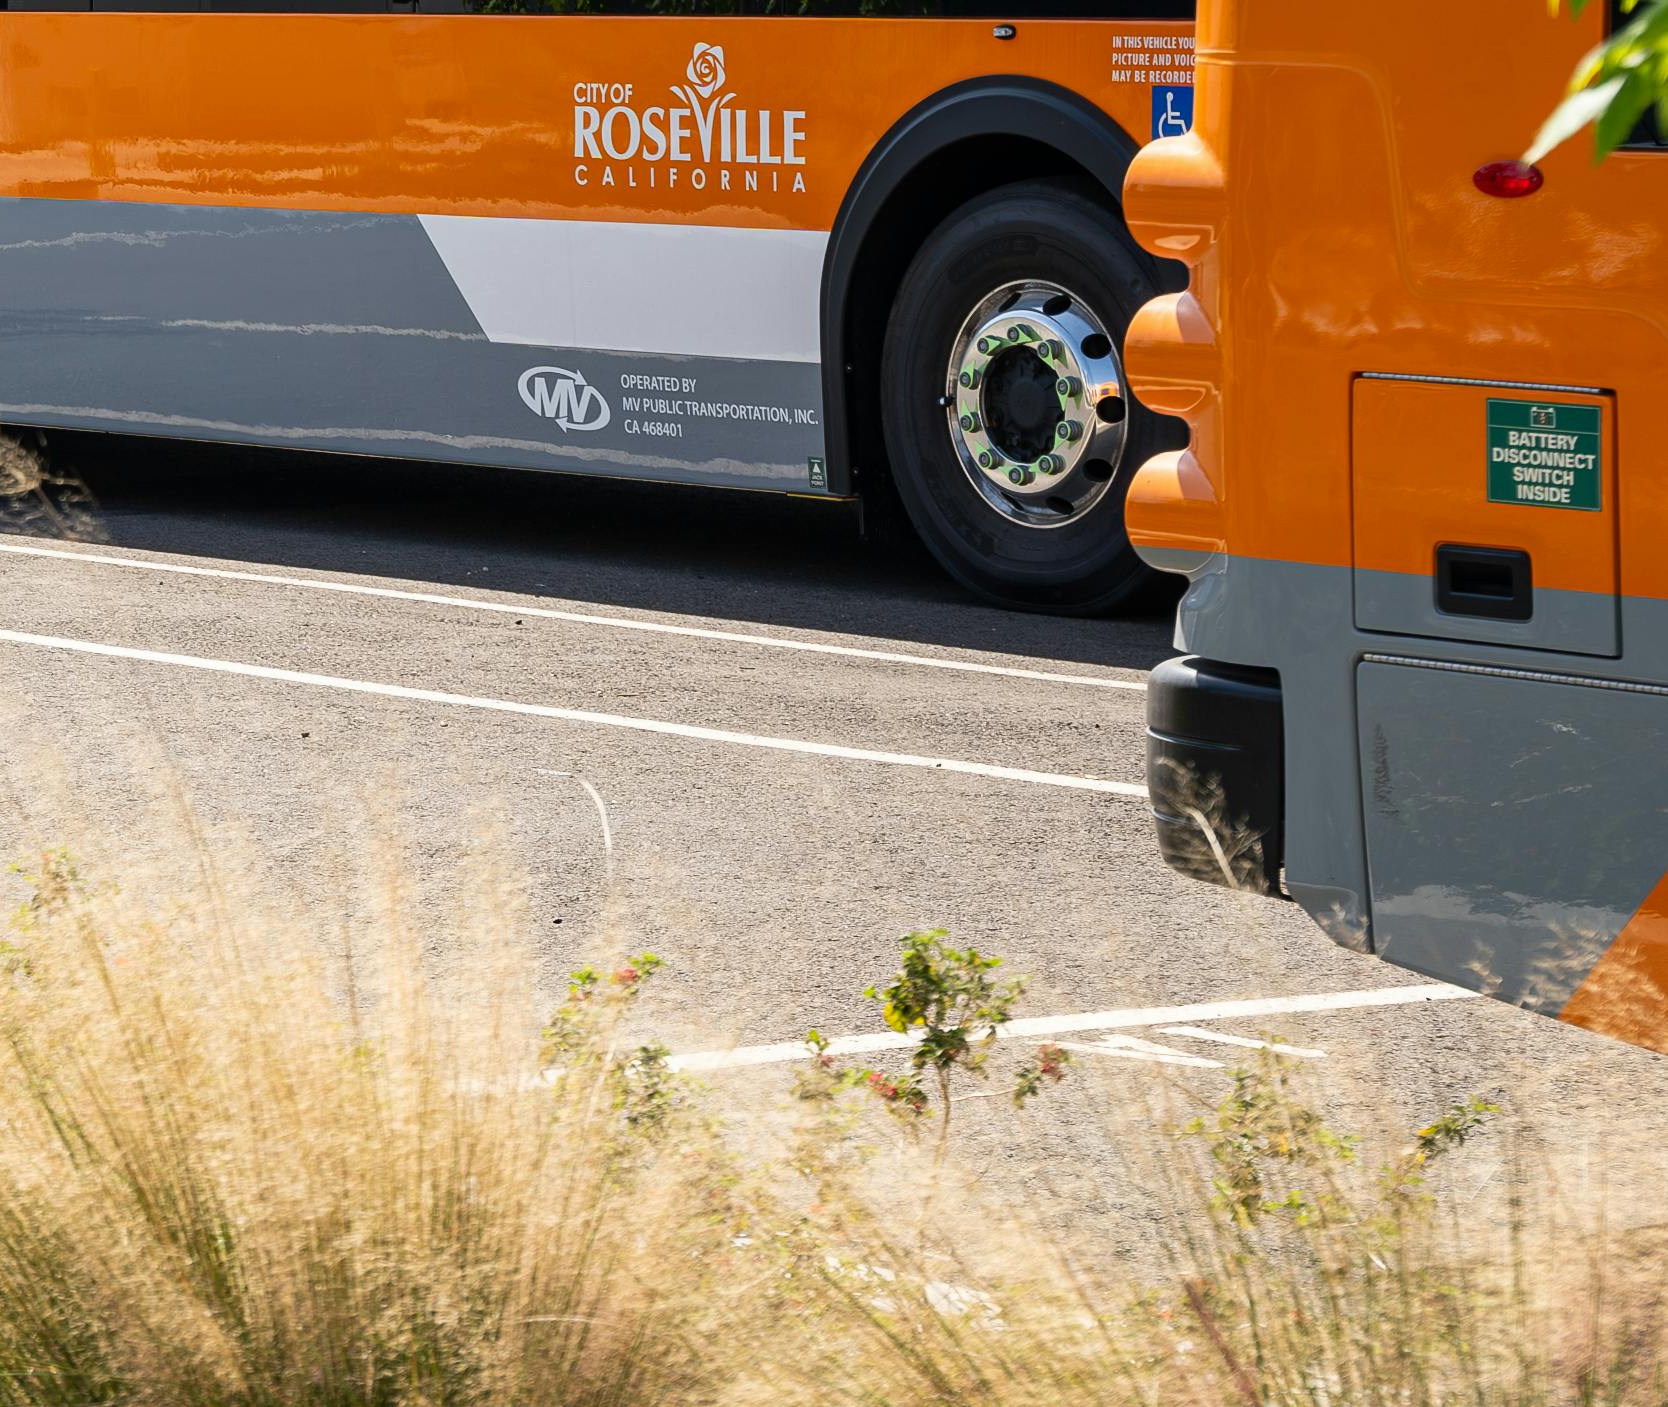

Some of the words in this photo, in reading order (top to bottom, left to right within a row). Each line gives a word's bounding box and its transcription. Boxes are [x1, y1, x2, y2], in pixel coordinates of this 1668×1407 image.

[1112, 36, 1122, 48] IN
[1123, 36, 1142, 48] THIS
[1143, 36, 1177, 49] VEHICLE
[1178, 37, 1195, 49] YOU
[1112, 53, 1150, 65] PICTURE
[1152, 54, 1172, 66] AND
[1174, 54, 1196, 66] VOIC
[1112, 70, 1131, 82] MAY
[1134, 70, 1146, 82] BE
[573, 82, 608, 103] CITY
[610, 83, 633, 104] OF
[574, 85, 806, 165] ROSEVILLE
[574, 164, 806, 193] CALIFORNIA
[620, 374, 679, 392] OPERATED
[682, 378, 696, 393] BY
[622, 397, 641, 412] MV
[643, 399, 684, 415] PUBLIC
[684, 401, 792, 425] TRANSPORTATION,
[794, 409, 819, 425] INC.
[624, 419, 641, 434] CA
[642, 421, 683, 437] 468401
[1508, 431, 1578, 450] BATTERY
[1492, 447, 1596, 470] DISCONNECT
[1512, 466, 1575, 486] SWITCH
[1517, 484, 1571, 503] INSIDE
